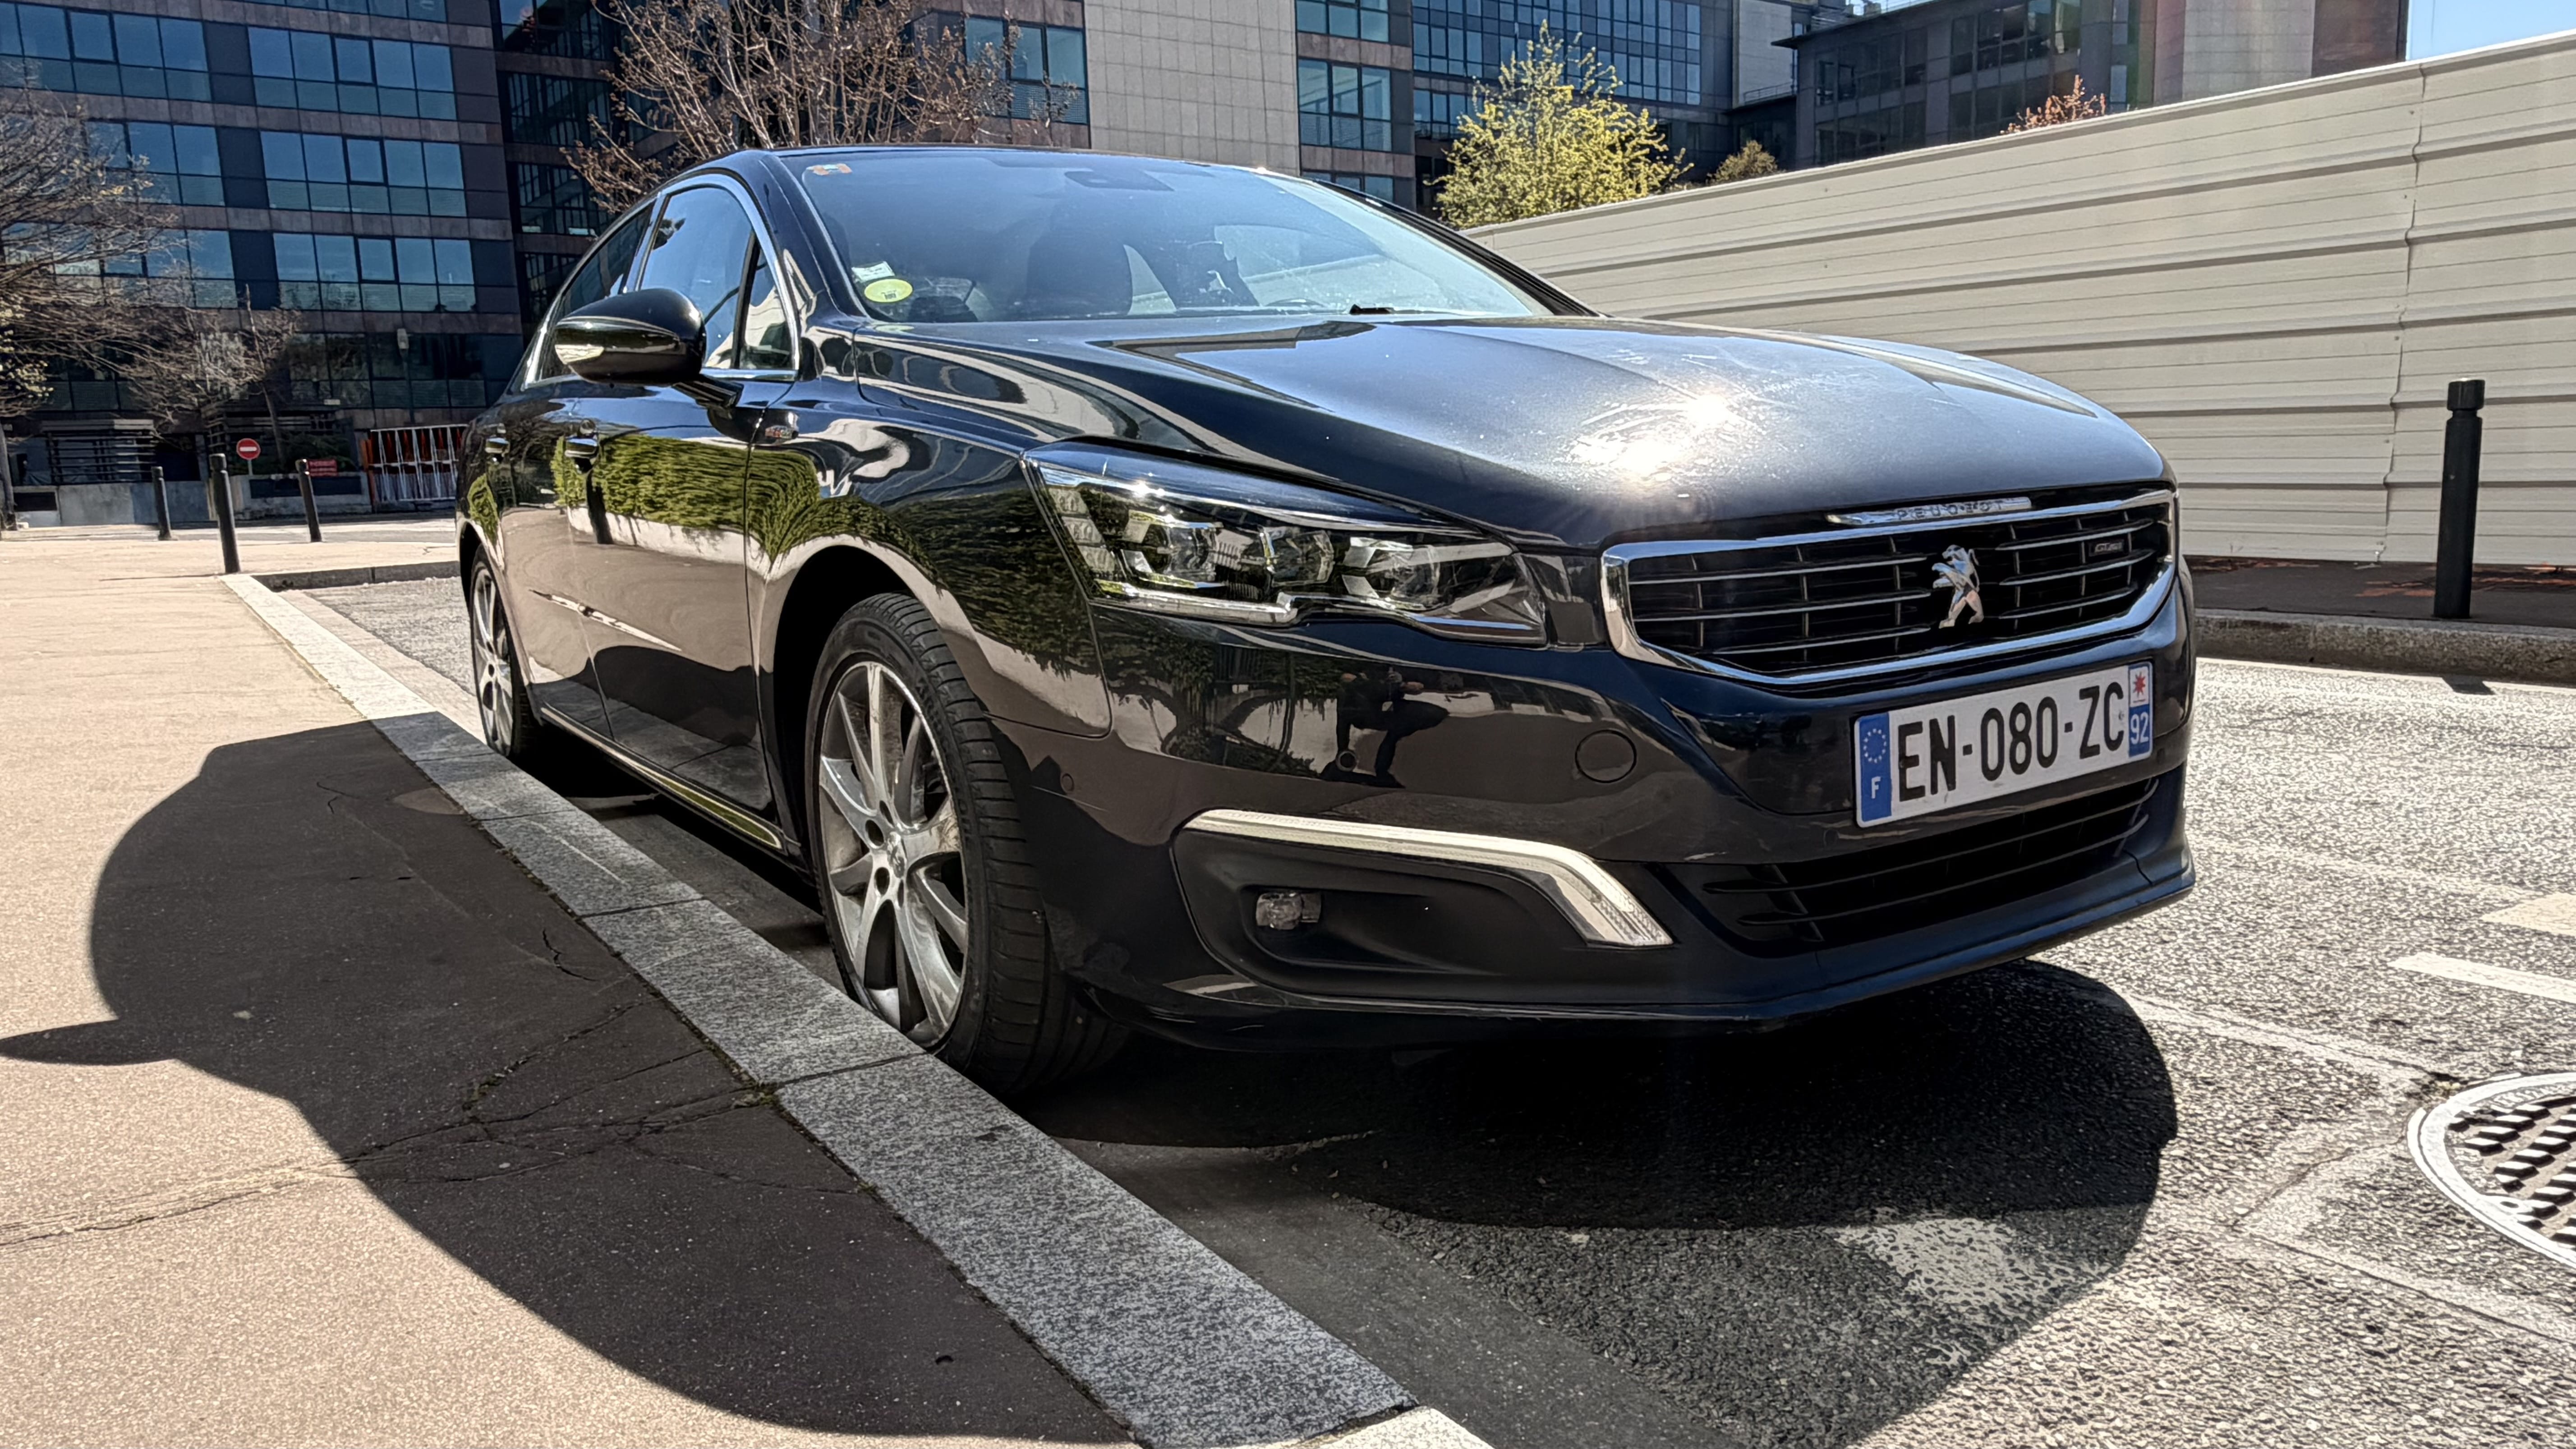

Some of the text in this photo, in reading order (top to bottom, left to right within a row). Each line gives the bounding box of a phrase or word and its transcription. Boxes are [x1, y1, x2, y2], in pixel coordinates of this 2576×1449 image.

[1898, 681, 2124, 802] EN-080-ZC
[2130, 711, 2149, 744] 92
[1871, 777, 1881, 799] F
